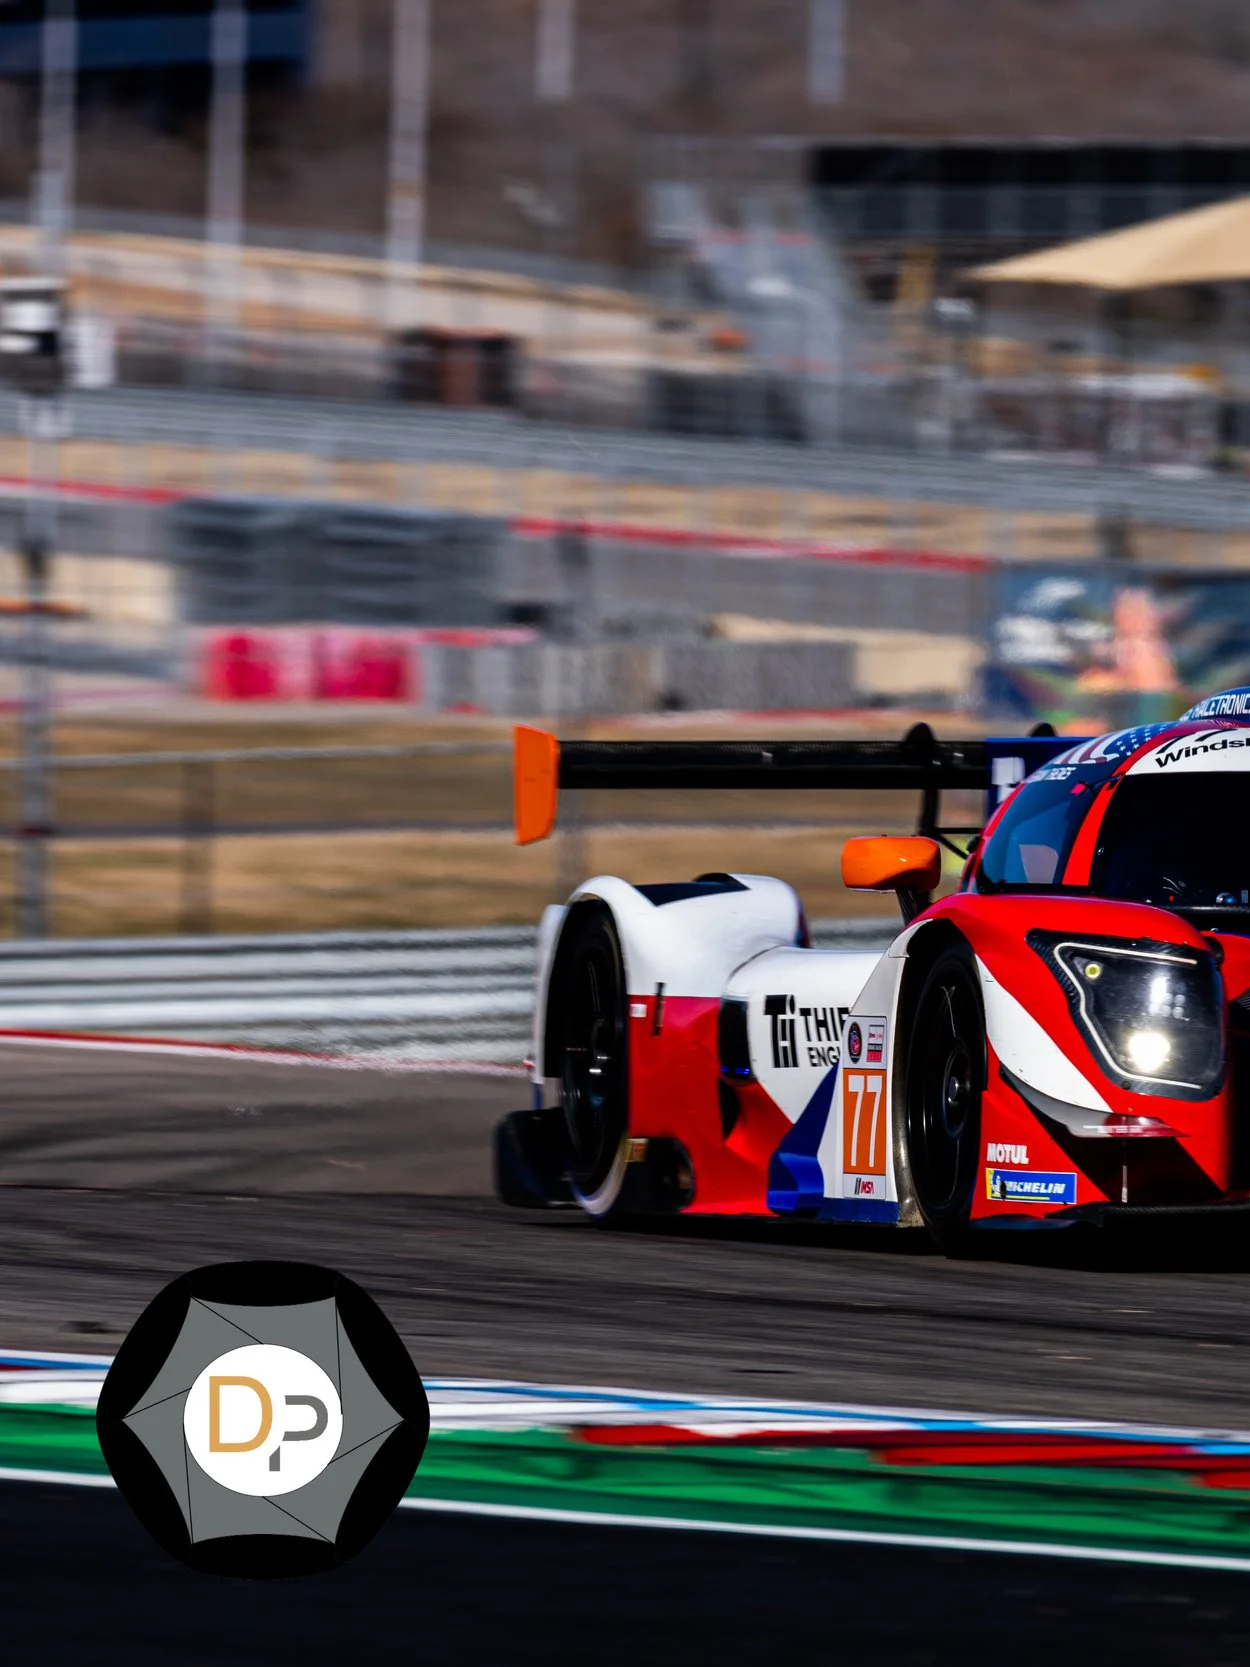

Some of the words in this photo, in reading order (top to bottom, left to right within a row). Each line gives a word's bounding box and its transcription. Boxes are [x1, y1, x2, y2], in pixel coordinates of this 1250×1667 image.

[848, 1074, 883, 1167] 77
[987, 1142, 1029, 1165] MOTUL
[1004, 1180, 1066, 1194] MICHELIN
